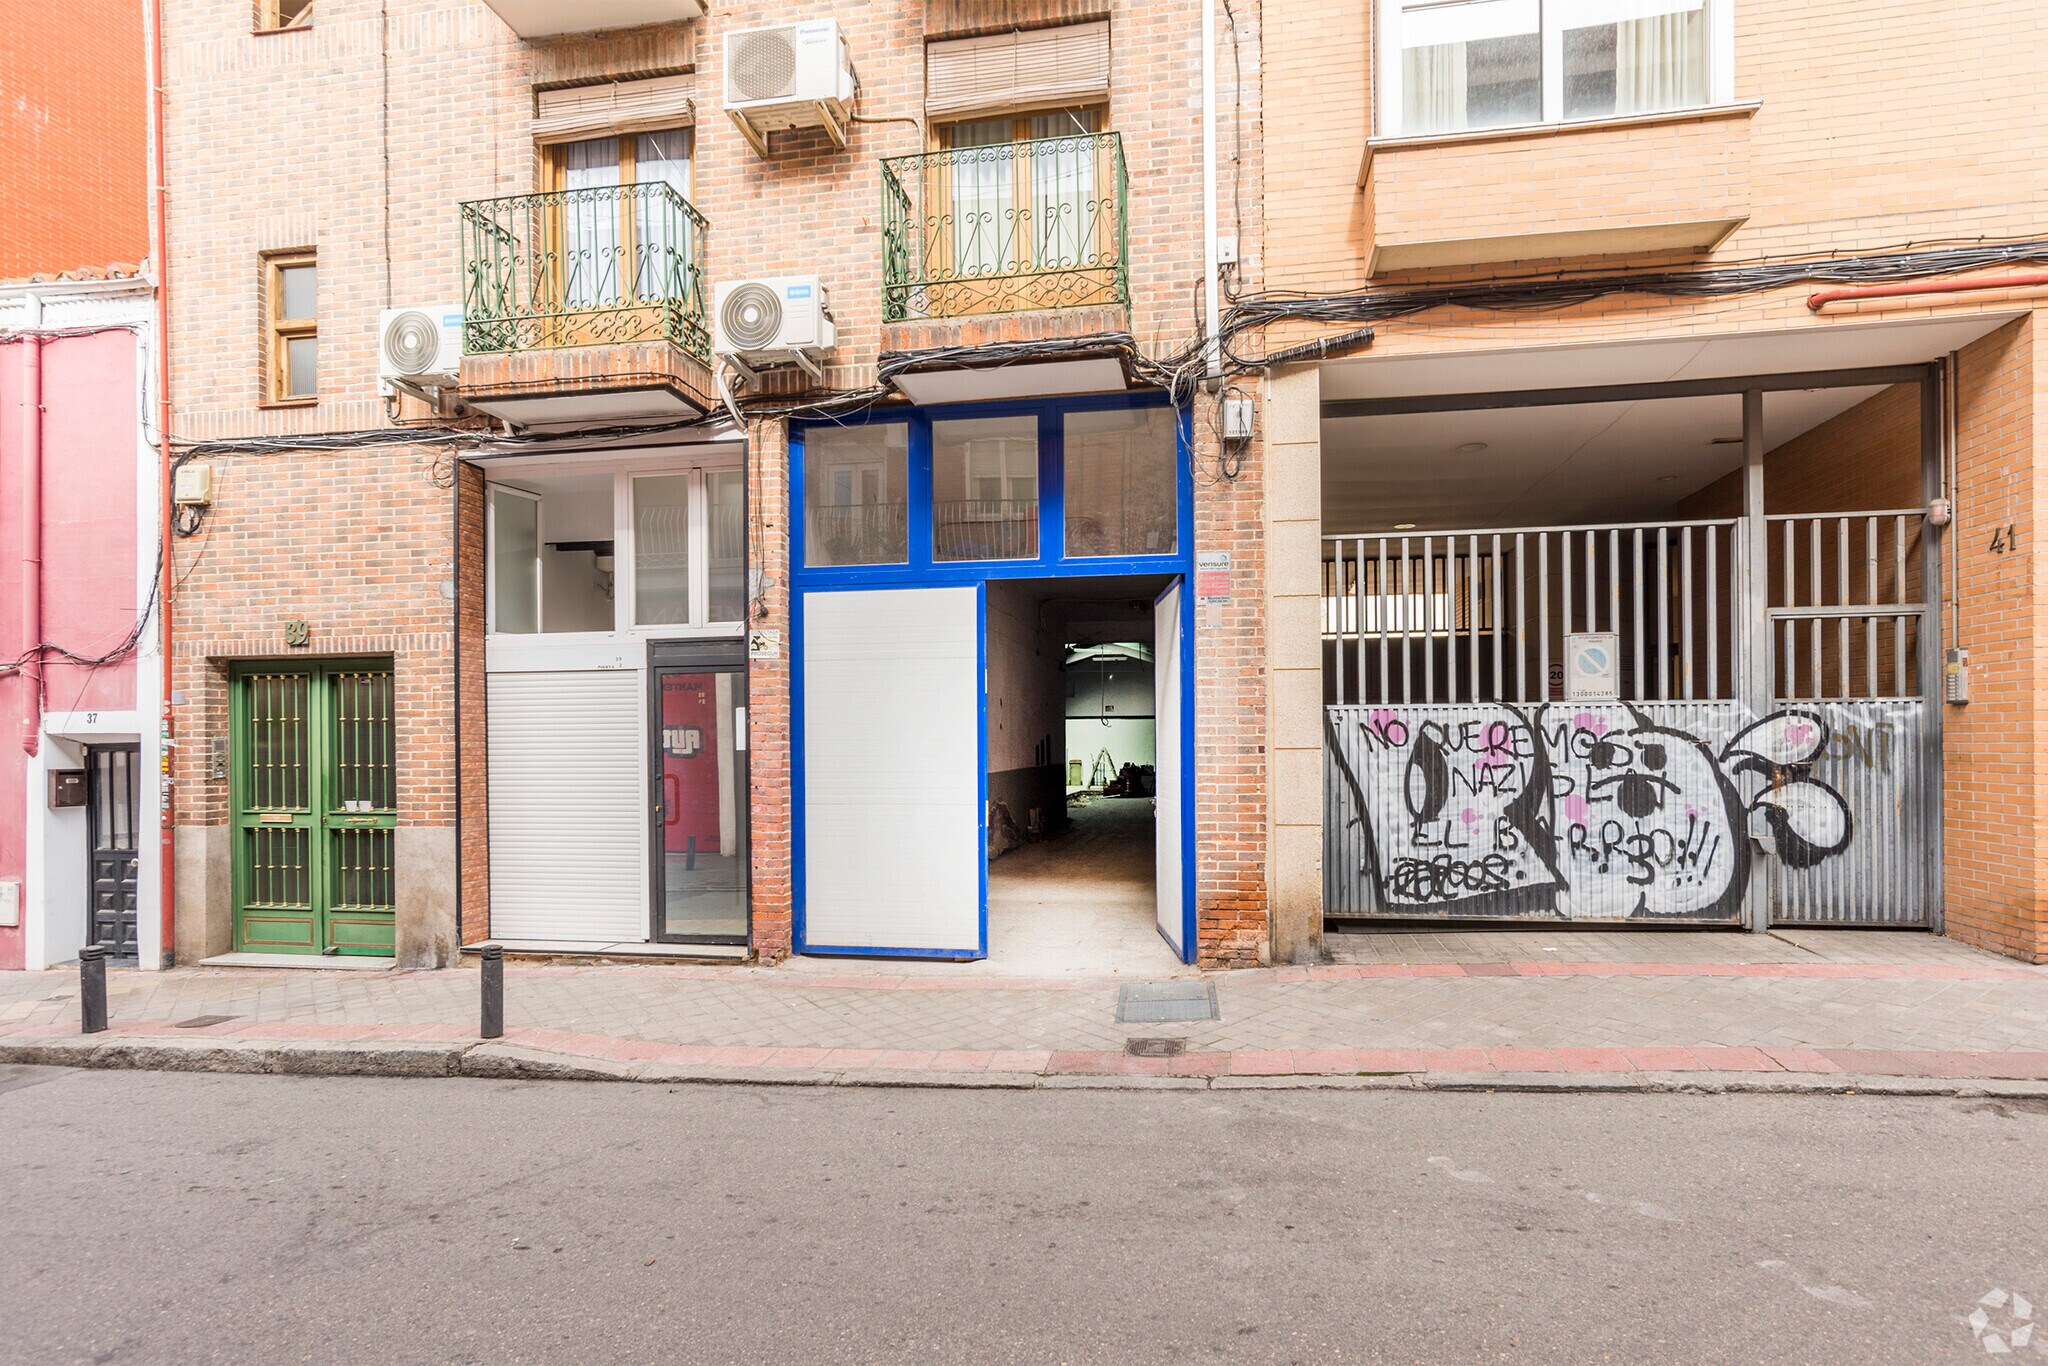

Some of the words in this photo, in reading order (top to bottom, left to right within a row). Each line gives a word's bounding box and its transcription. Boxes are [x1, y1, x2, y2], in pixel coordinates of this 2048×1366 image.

[1990, 524, 2017, 554] 41
[286, 623, 308, 645] 39
[1549, 671, 1563, 680] 20
[87, 713, 98, 724] 37
[1359, 719, 1409, 752] NO
[1410, 819, 1469, 848] EL
